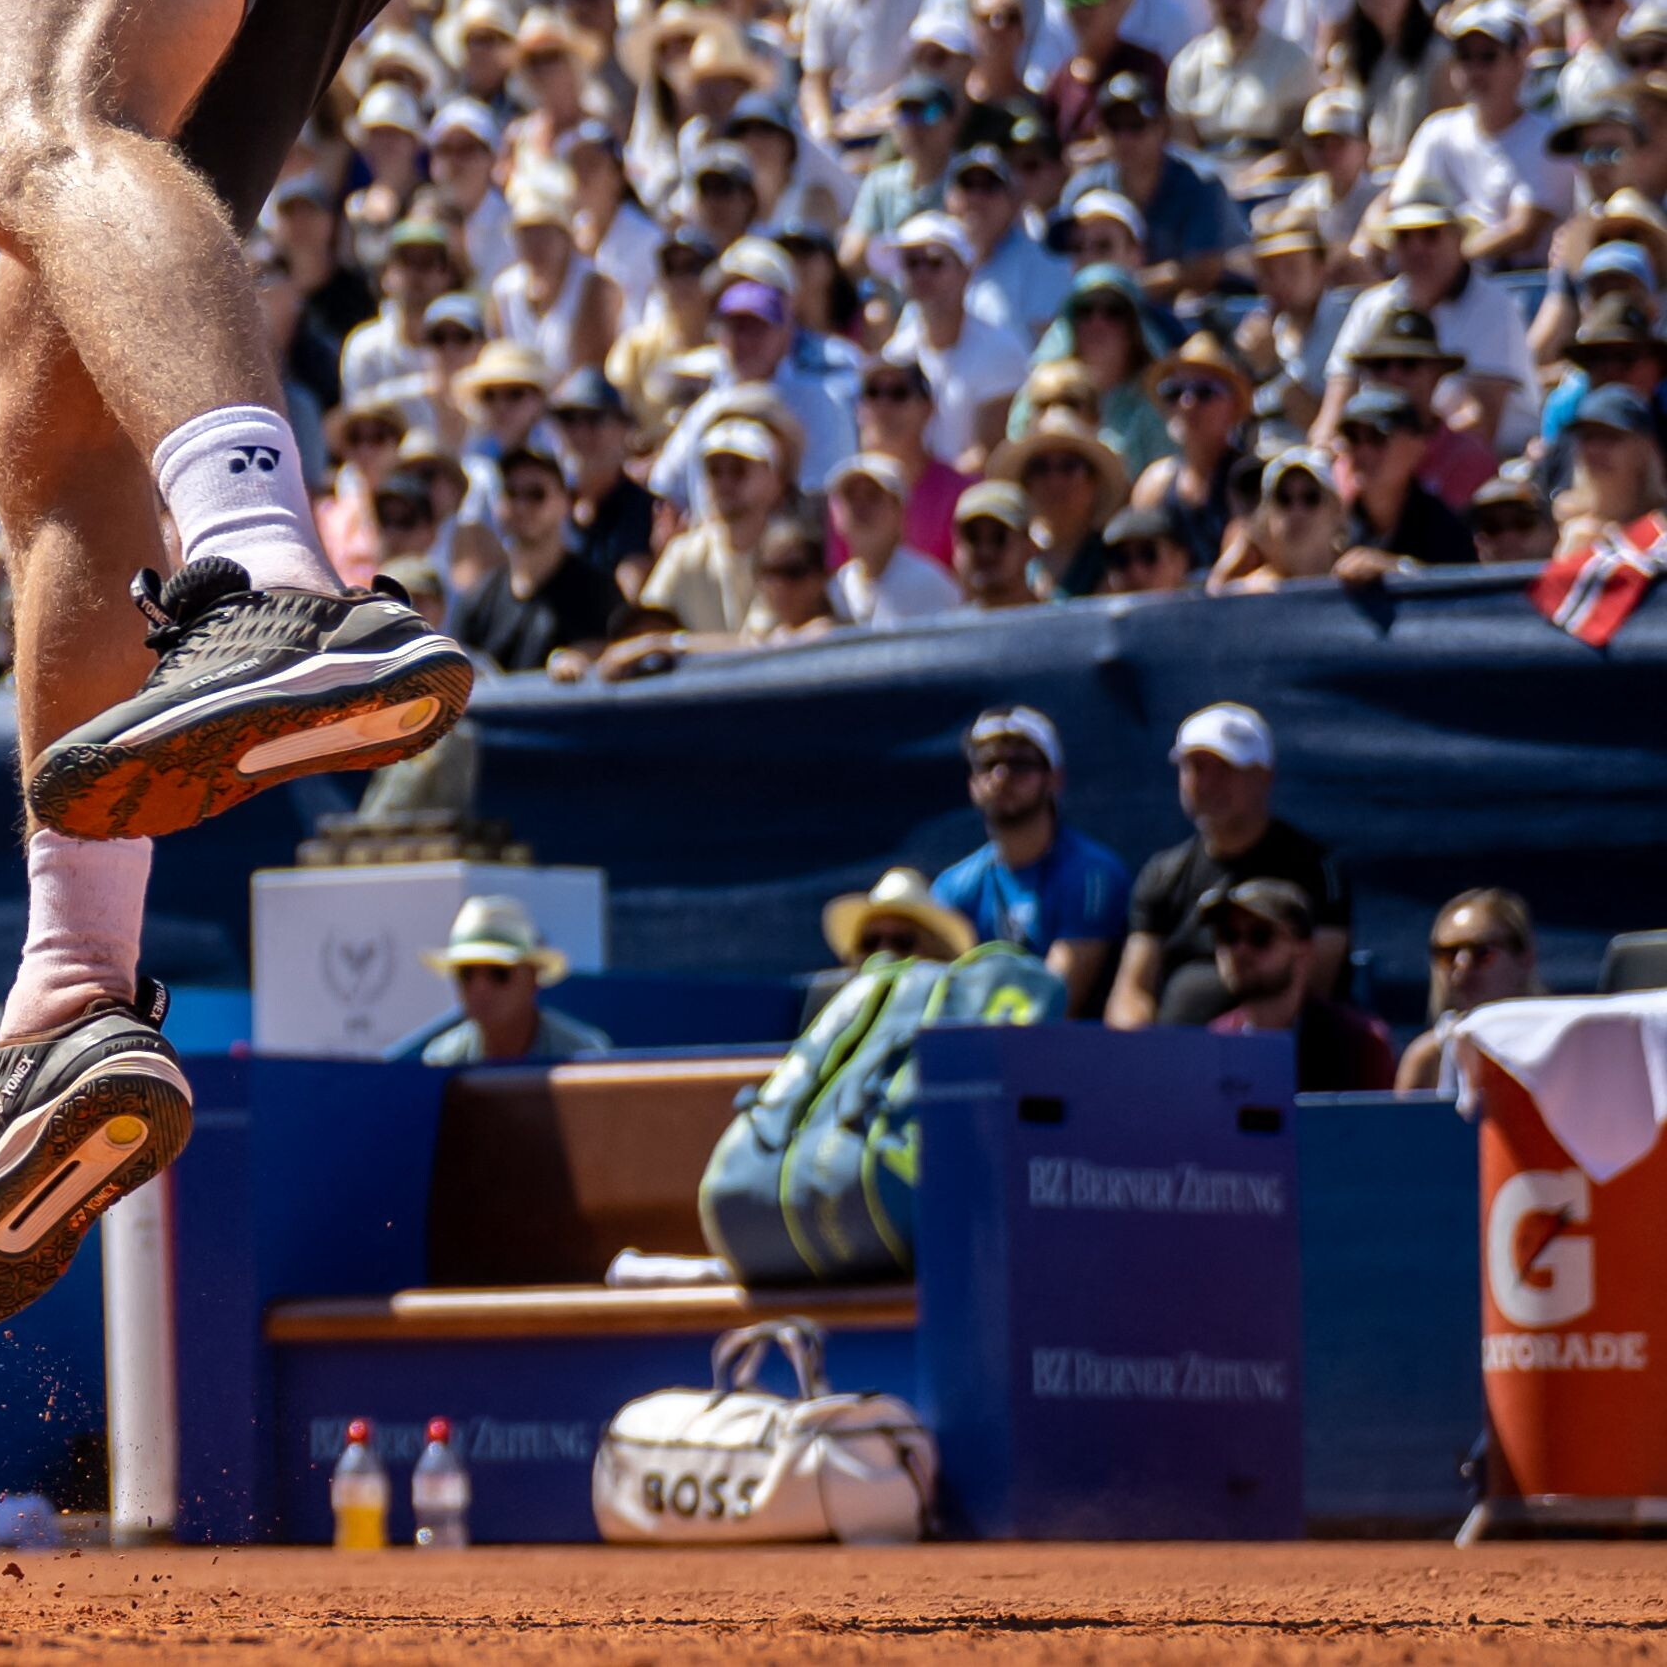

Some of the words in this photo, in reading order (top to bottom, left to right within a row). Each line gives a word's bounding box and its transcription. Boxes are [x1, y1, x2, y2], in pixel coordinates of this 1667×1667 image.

[0, 1053, 36, 1100] YONEX
[1029, 1156, 1068, 1209] BZ
[1070, 1158, 1171, 1211] BERNER
[1176, 1161, 1285, 1217] ZEITUNG
[1488, 1167, 1594, 1327] G
[1032, 1347, 1071, 1398] BZ
[1074, 1348, 1174, 1400] BERNER
[1179, 1351, 1286, 1403] ZEITUNG
[641, 1472, 761, 1519] BOSS
